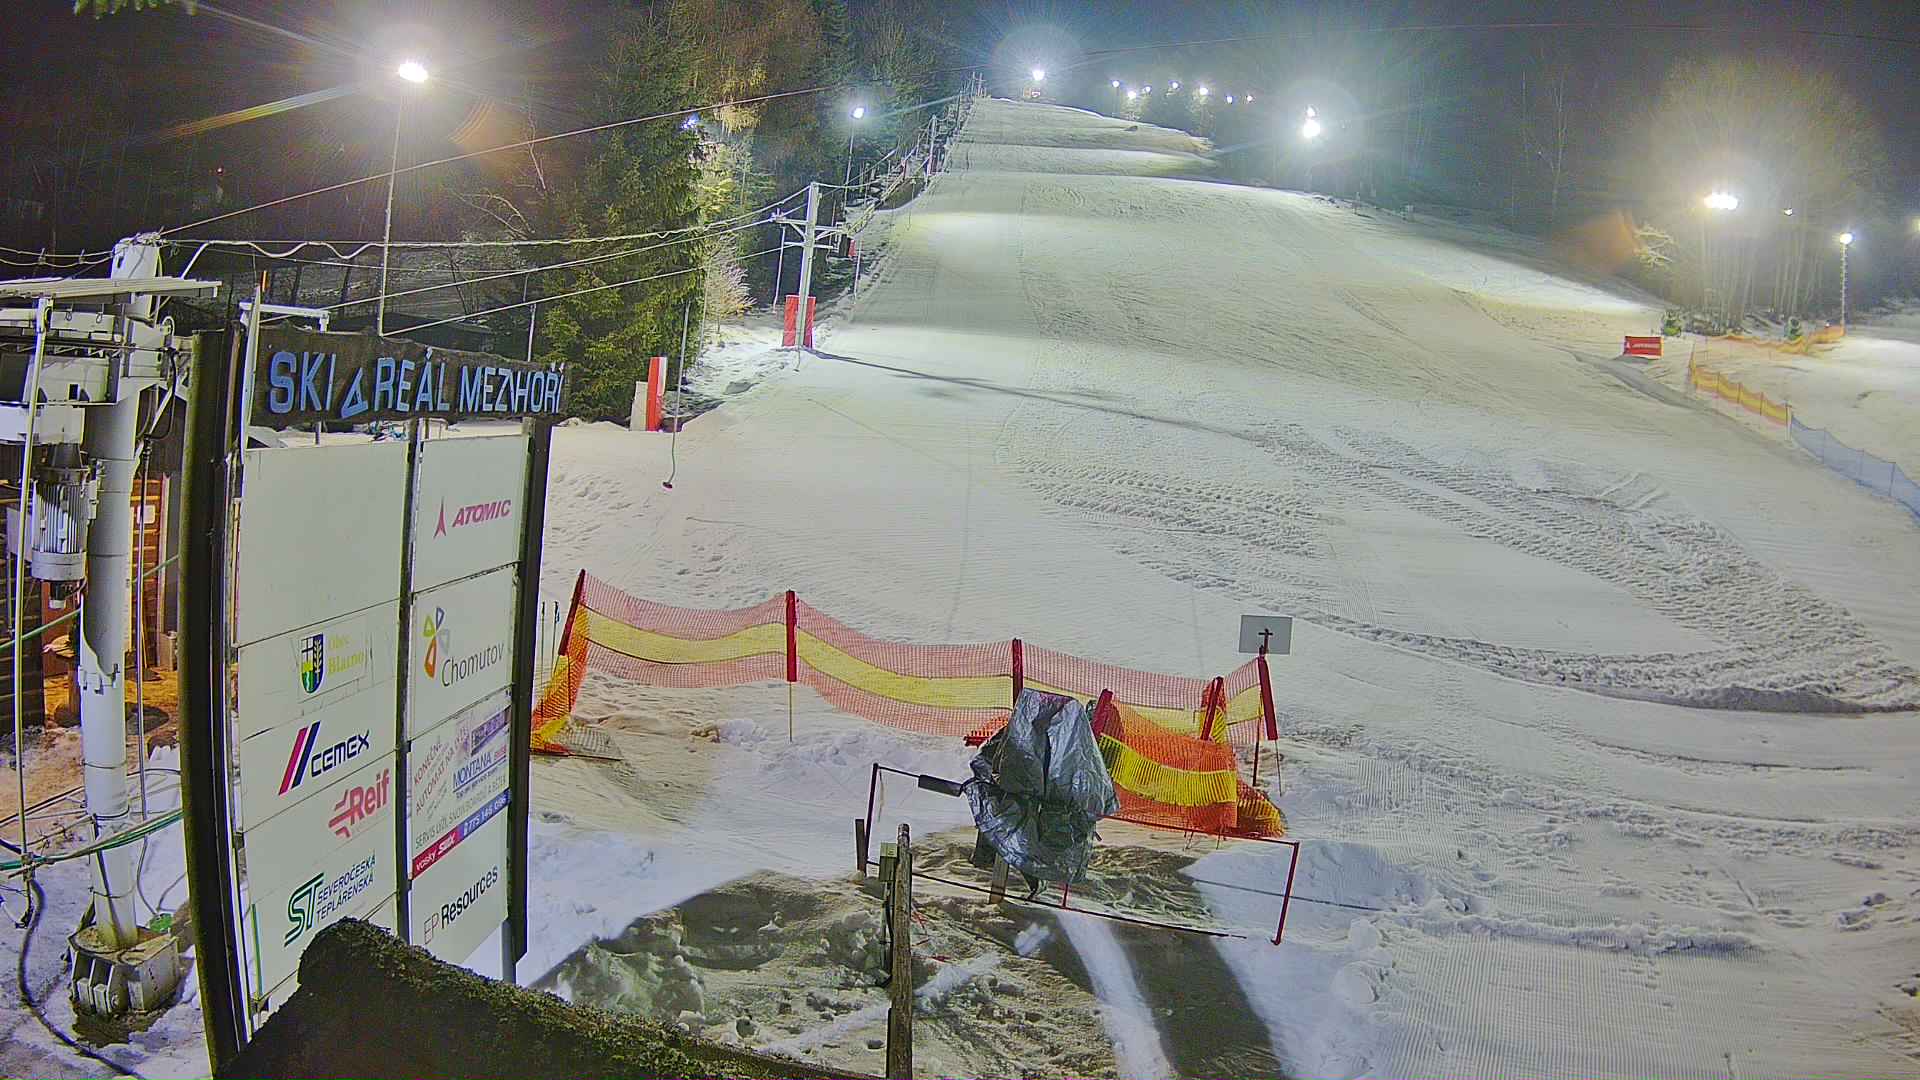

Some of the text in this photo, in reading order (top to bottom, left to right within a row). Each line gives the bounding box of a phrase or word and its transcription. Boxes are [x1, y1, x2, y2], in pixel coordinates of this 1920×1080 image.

[270, 351, 336, 414] SKI
[452, 500, 512, 527] ATOMIC
[441, 642, 504, 687] Chomutov
[311, 730, 370, 778] CEMEX
[453, 751, 492, 791] MONTANA
[350, 768, 390, 825] Reif
[316, 870, 374, 922] TEPLÁRENSKÁ
[317, 850, 376, 905] SEVEROČESKÁ
[441, 866, 498, 929] Resources
